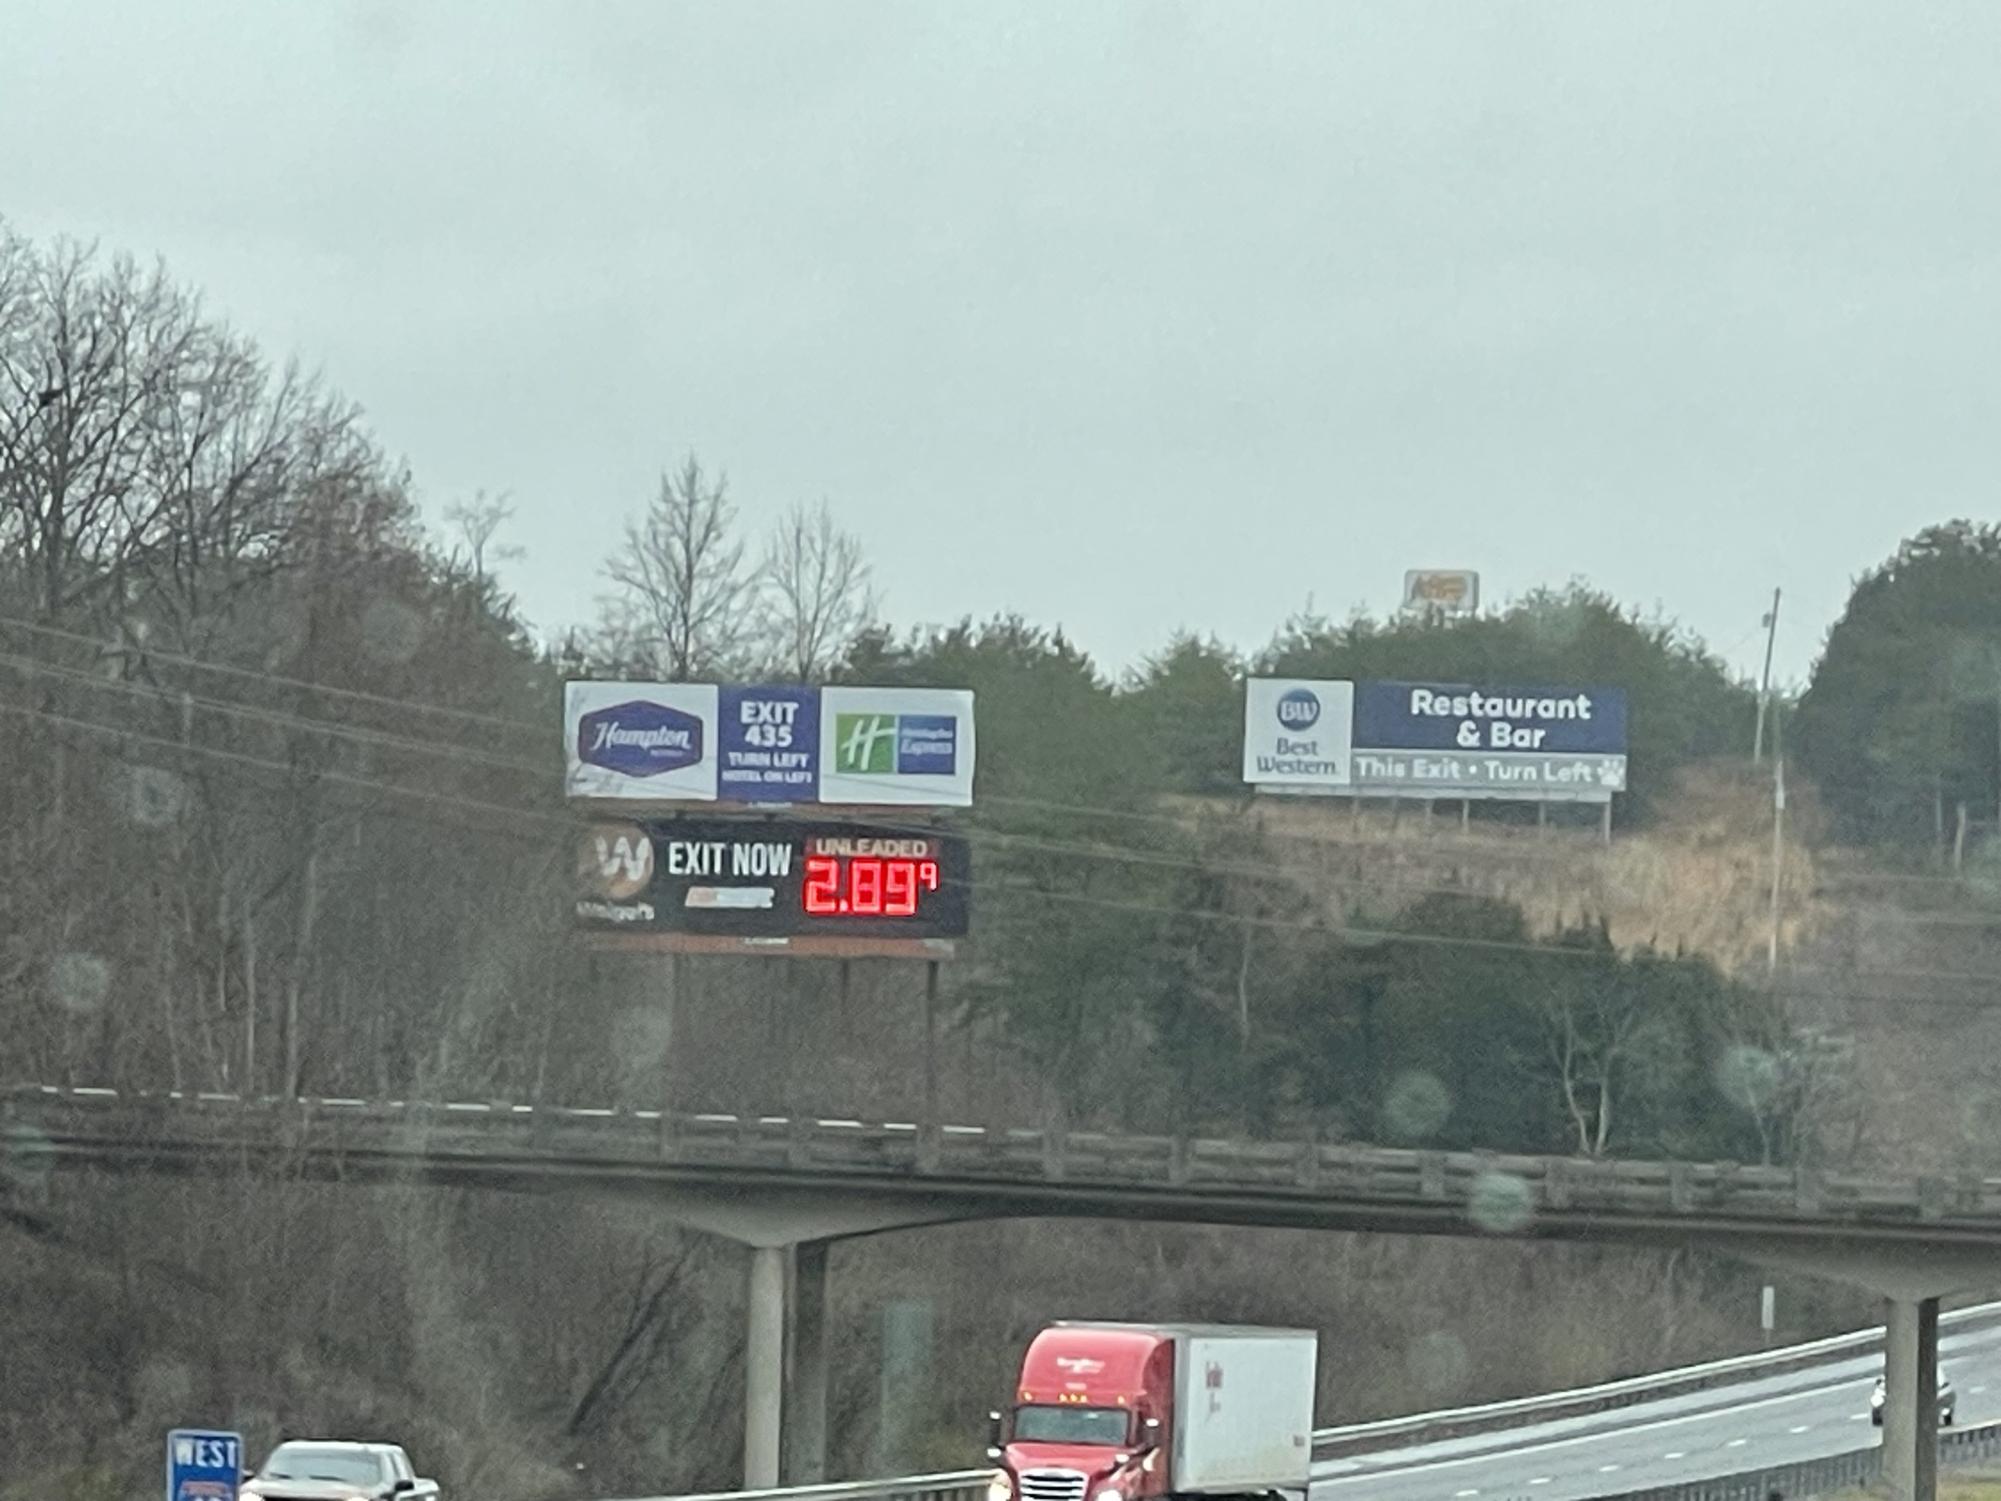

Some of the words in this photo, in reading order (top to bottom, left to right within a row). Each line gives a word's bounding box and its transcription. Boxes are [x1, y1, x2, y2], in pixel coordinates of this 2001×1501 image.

[740, 701, 799, 724] EXIT
[1279, 700, 1318, 721] BW
[1410, 689, 1592, 719] Restaurant
[591, 721, 692, 751] Hampton
[744, 724, 793, 747] 435
[1456, 720, 1481, 748] &
[1490, 721, 1547, 749] Bar
[1276, 737, 1318, 756] Best
[728, 752, 771, 767] TURN
[773, 753, 809, 768] LEFT
[1256, 757, 1336, 775] Western
[1356, 756, 1405, 779] This
[1412, 759, 1461, 780] Exit
[1484, 760, 1537, 781] Turn
[1544, 761, 1593, 783] Left
[668, 841, 726, 876] EXIT
[732, 842, 792, 877] NOW
[815, 838, 928, 857] UNLEADED
[175, 1438, 237, 1468] WEST
